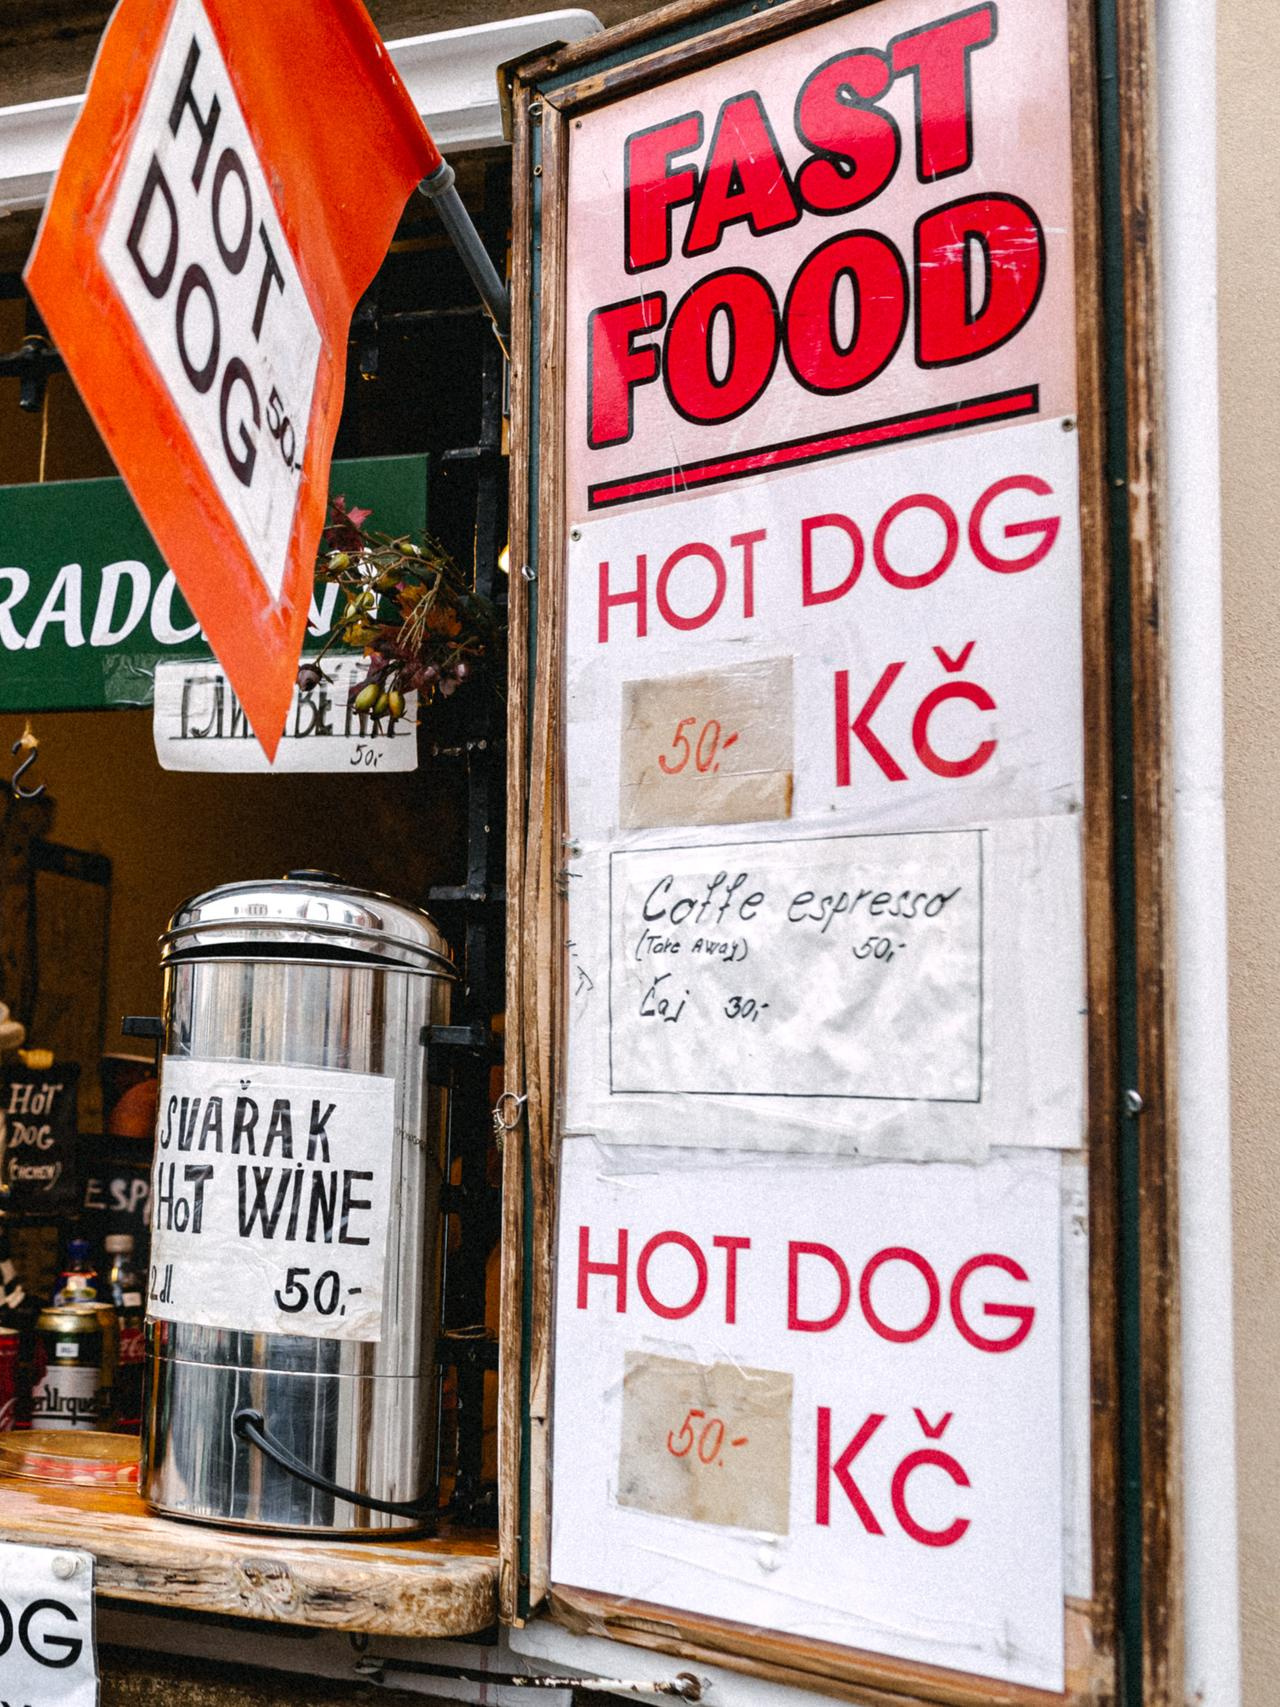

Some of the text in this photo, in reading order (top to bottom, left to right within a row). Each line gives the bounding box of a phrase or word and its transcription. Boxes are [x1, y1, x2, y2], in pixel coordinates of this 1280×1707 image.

[167, 34, 286, 343] HOT
[624, 1, 998, 275] FAST
[125, 152, 262, 489] DOG
[587, 192, 1047, 450] FOOD
[598, 474, 1062, 644] HOT DOG
[643, 871, 961, 933] Coffe espresso
[576, 1225, 1036, 1354] HOT DOG
